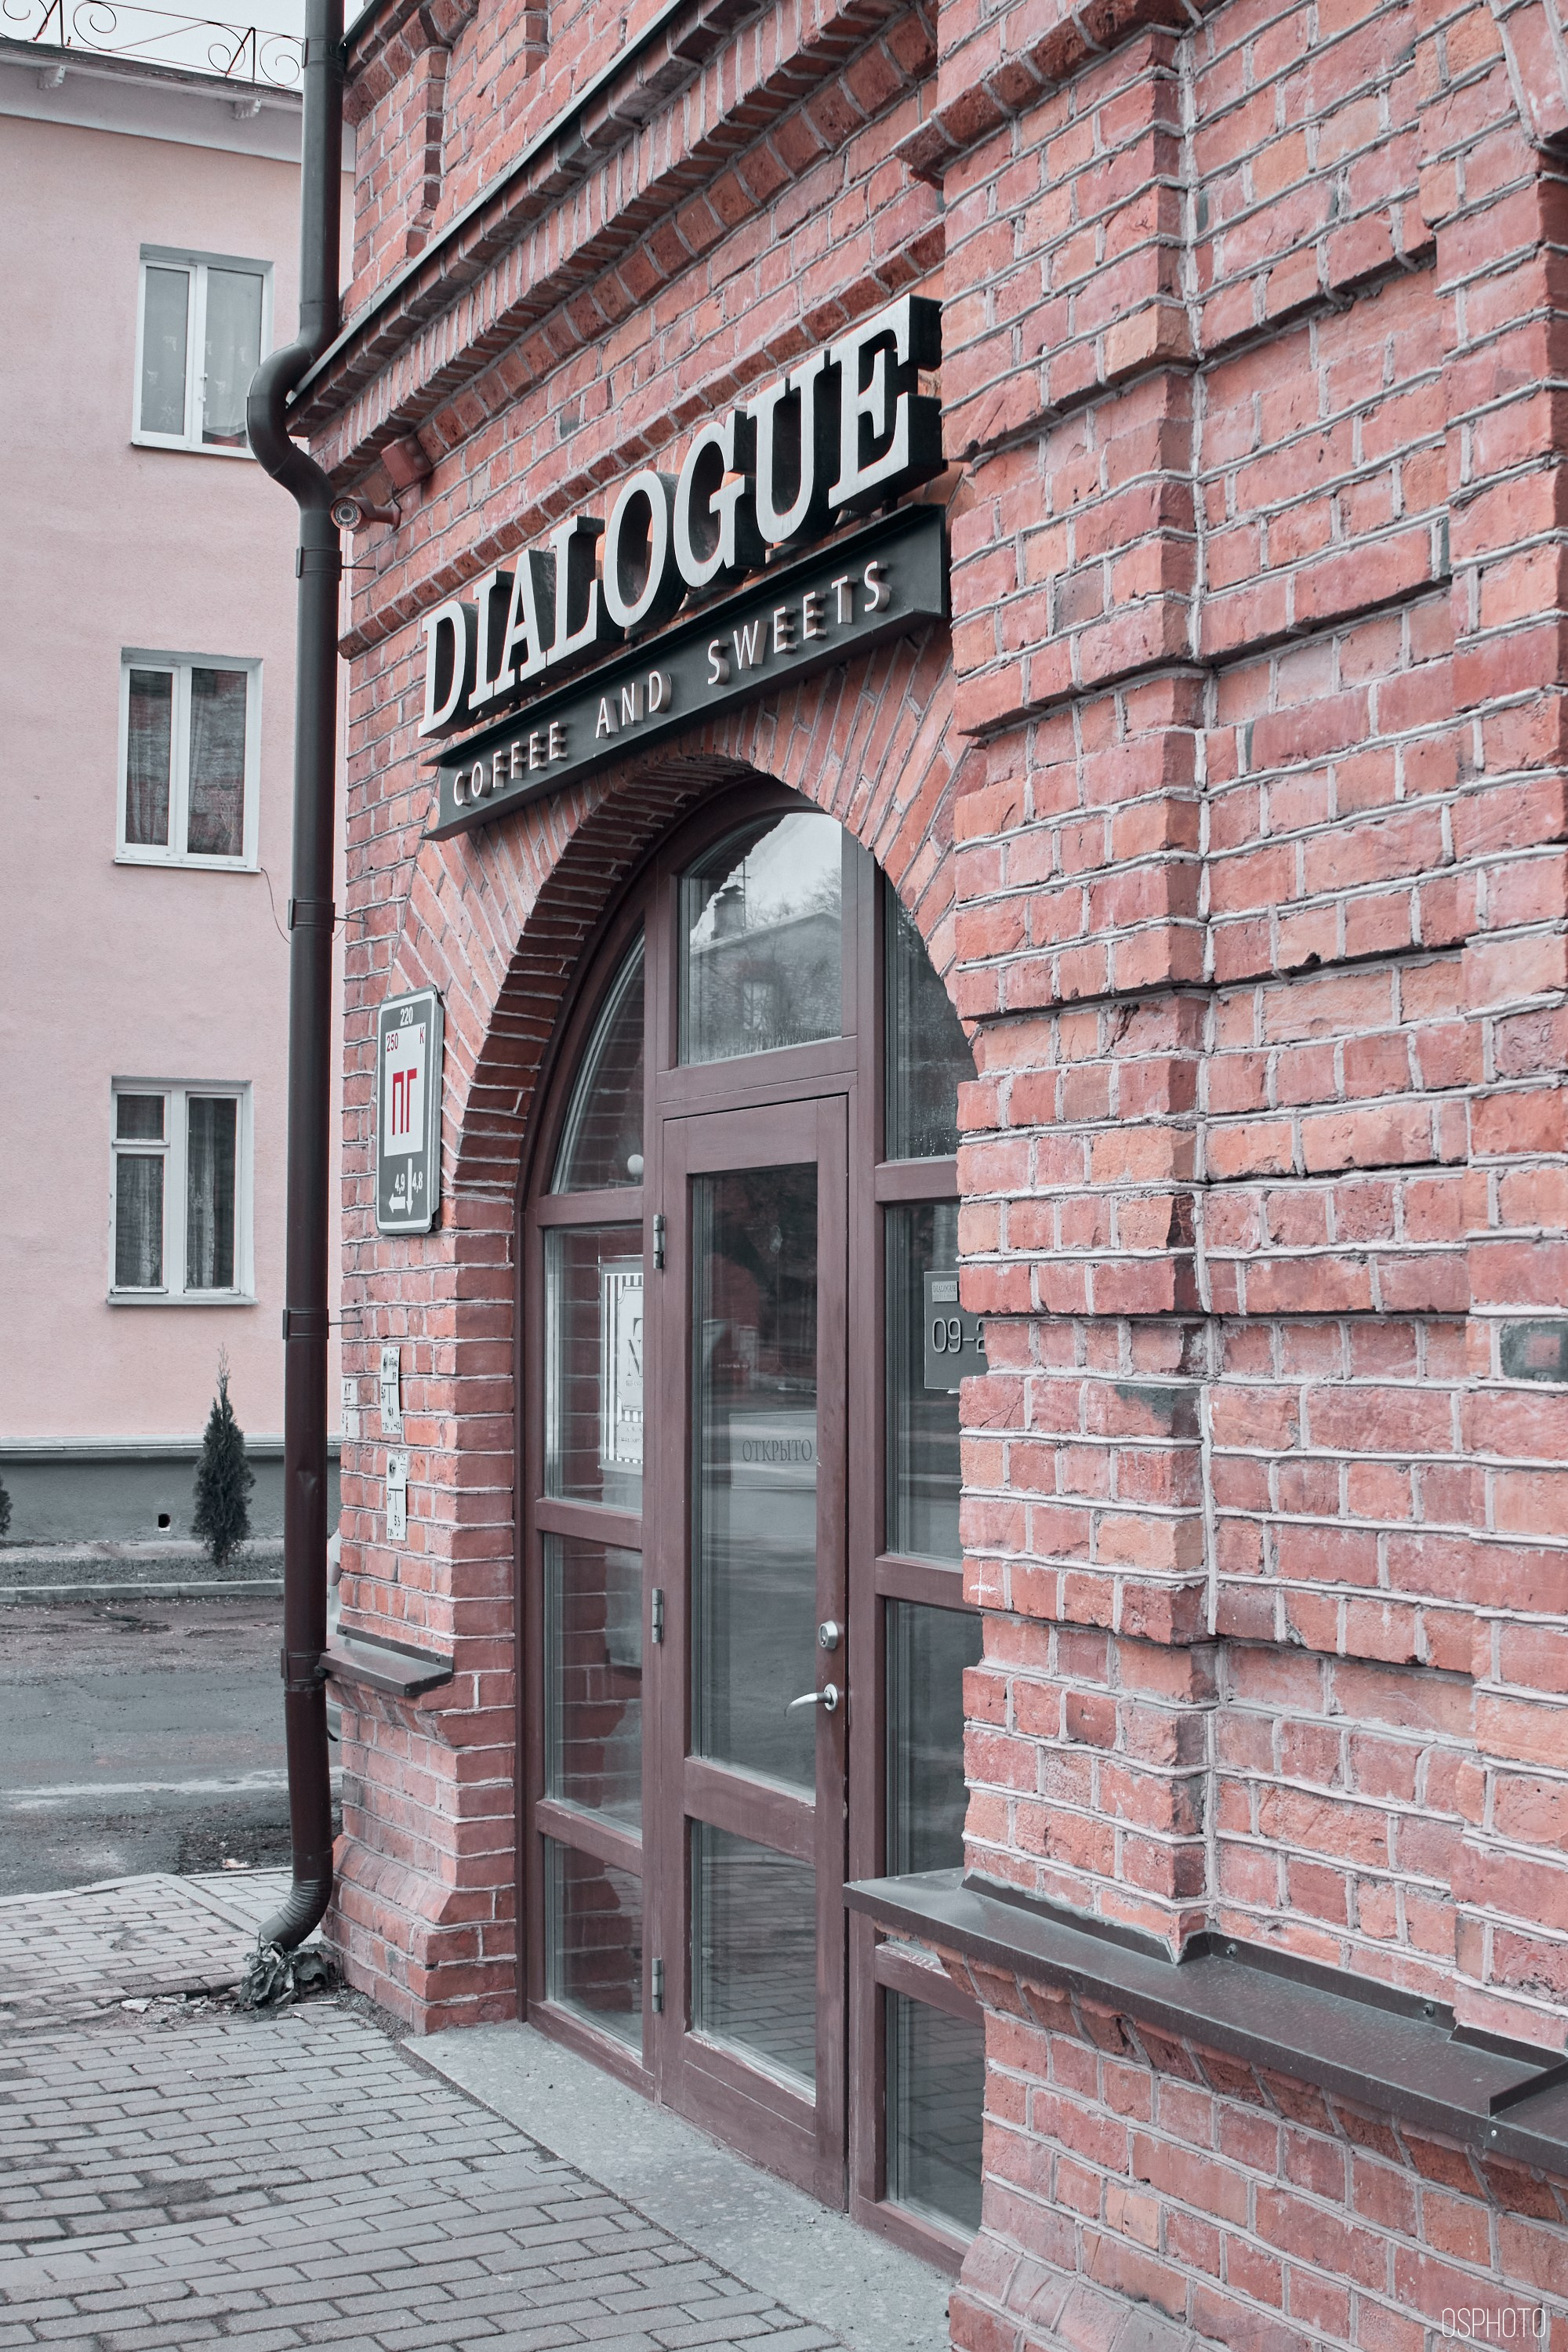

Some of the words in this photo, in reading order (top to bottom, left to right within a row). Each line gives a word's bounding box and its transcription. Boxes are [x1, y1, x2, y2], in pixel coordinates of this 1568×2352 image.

[418, 292, 925, 738] DIALOGUE
[452, 721, 564, 807] COFFEE
[595, 670, 668, 739] AND
[707, 560, 886, 685] SWEETS
[400, 1006, 413, 1026] 220
[387, 1032, 398, 1052] 250
[392, 1068, 417, 1136] ПГ
[394, 1172, 405, 1195] 4,9
[412, 1171, 423, 1193] 4,8
[742, 1439, 812, 1462] ОТКРЫТО
